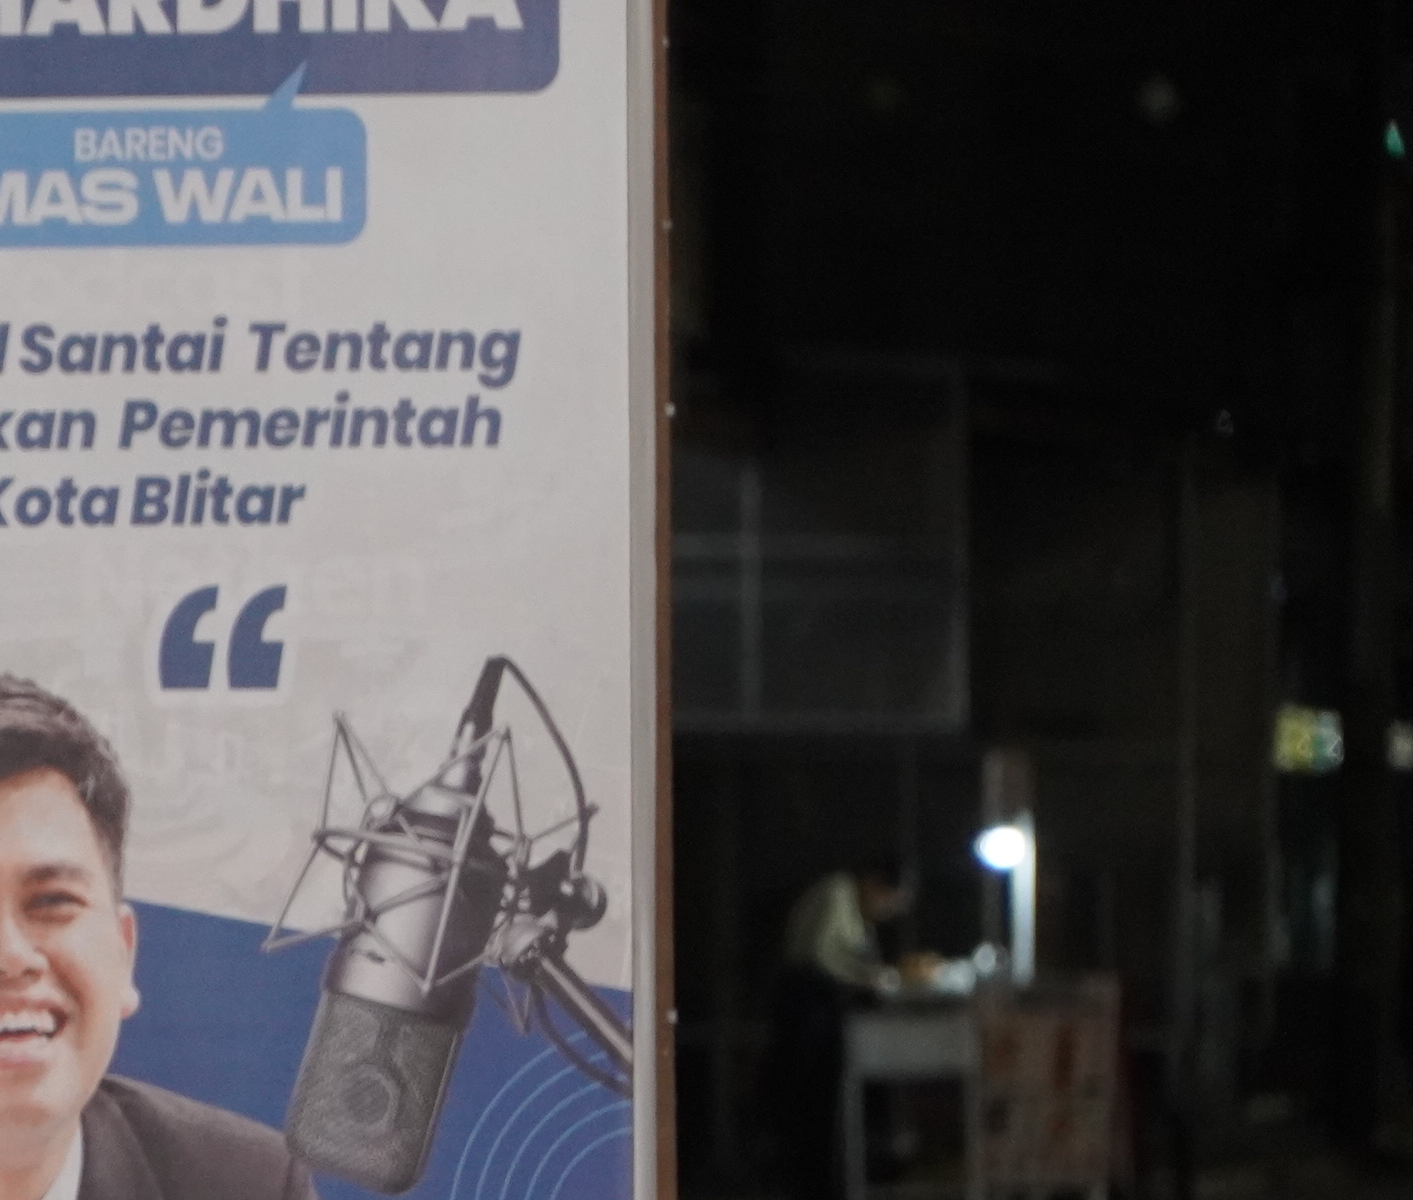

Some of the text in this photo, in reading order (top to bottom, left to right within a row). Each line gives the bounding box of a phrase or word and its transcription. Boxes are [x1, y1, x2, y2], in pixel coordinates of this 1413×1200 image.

[73, 125, 226, 164] BARENG
[153, 165, 343, 224] WALI
[19, 316, 228, 375] Santai
[249, 322, 521, 390] Tentang
[118, 391, 502, 451] Pemerintah
[129, 468, 306, 527] Blitar
